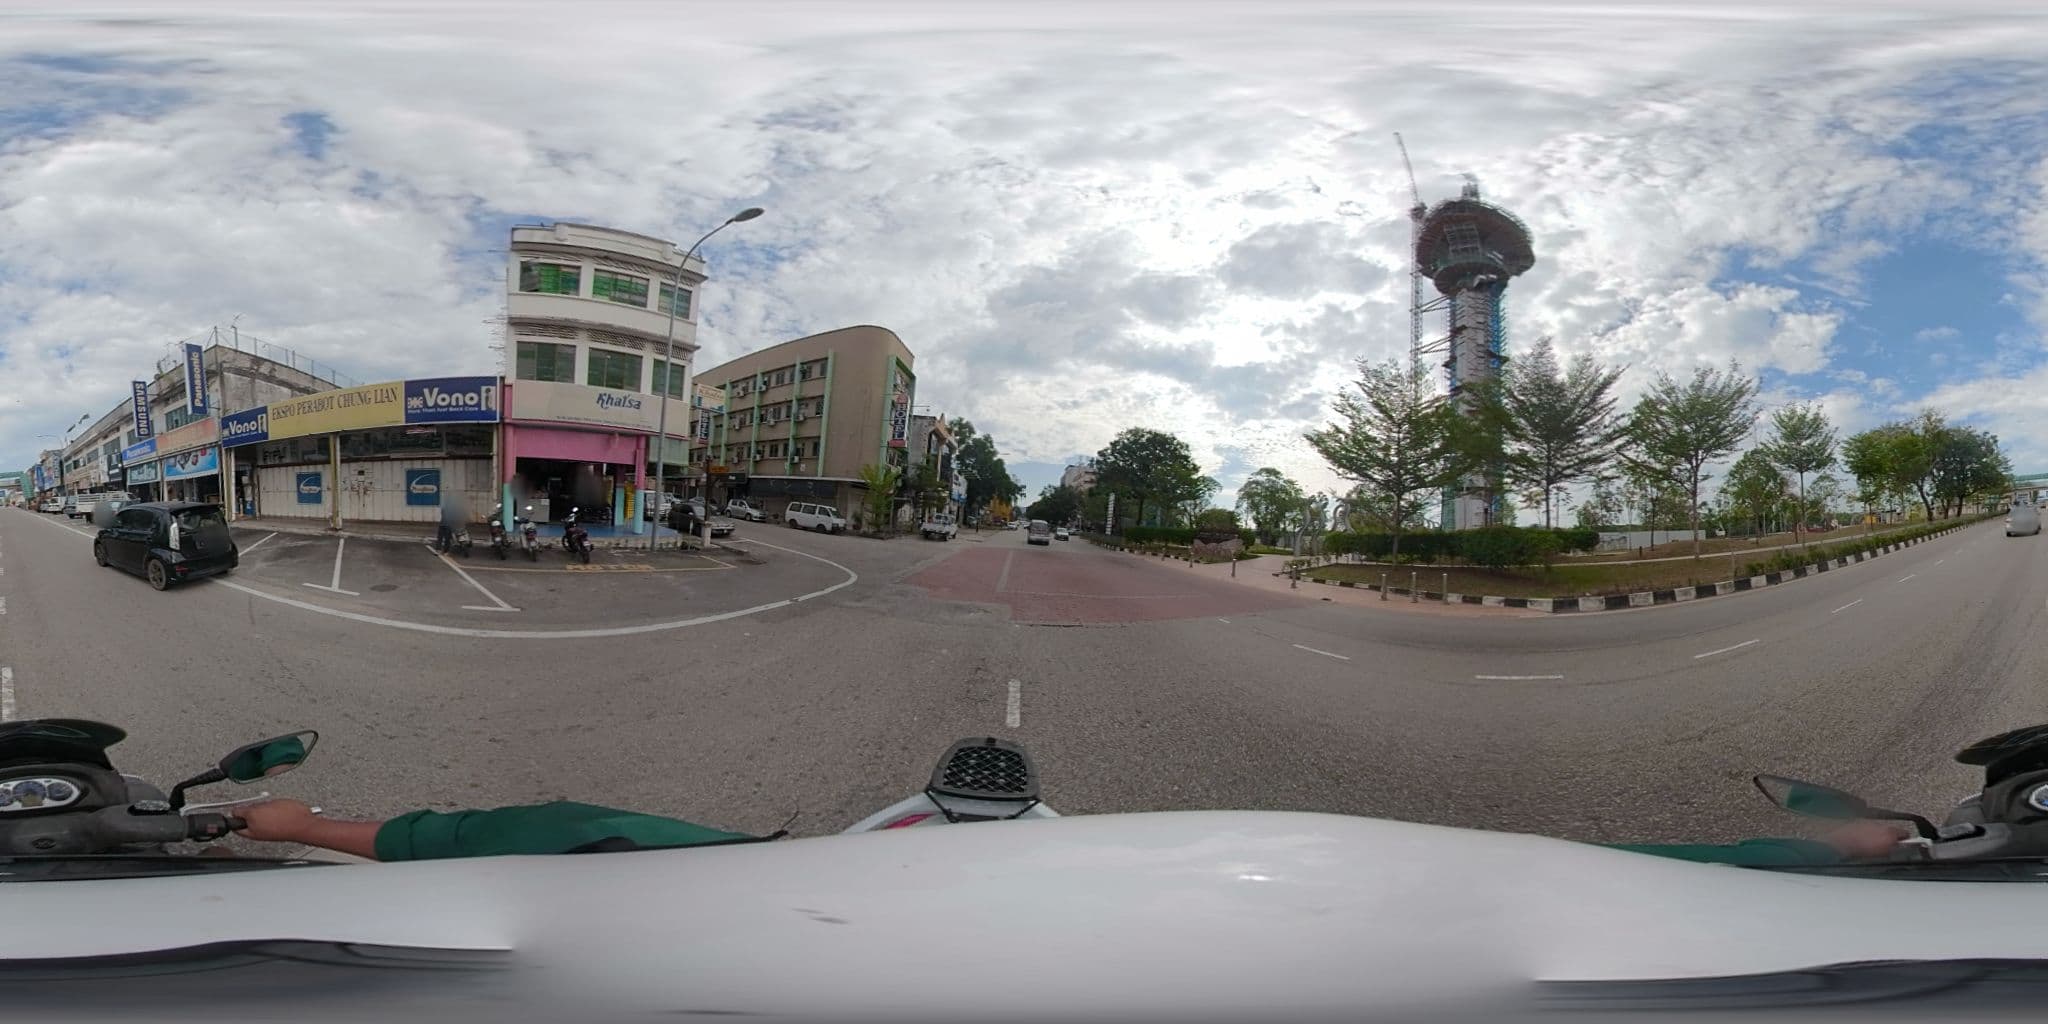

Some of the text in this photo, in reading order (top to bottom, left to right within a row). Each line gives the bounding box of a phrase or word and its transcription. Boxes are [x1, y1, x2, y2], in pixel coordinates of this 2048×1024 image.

[191, 352, 203, 407] Panasonic
[423, 387, 479, 407] Vono
[135, 383, 148, 435] SAMSUNG
[272, 387, 398, 420] EKSPO PERABOT CHUNG LIAN
[229, 420, 257, 435] Vono
[894, 403, 907, 440] HOTEL
